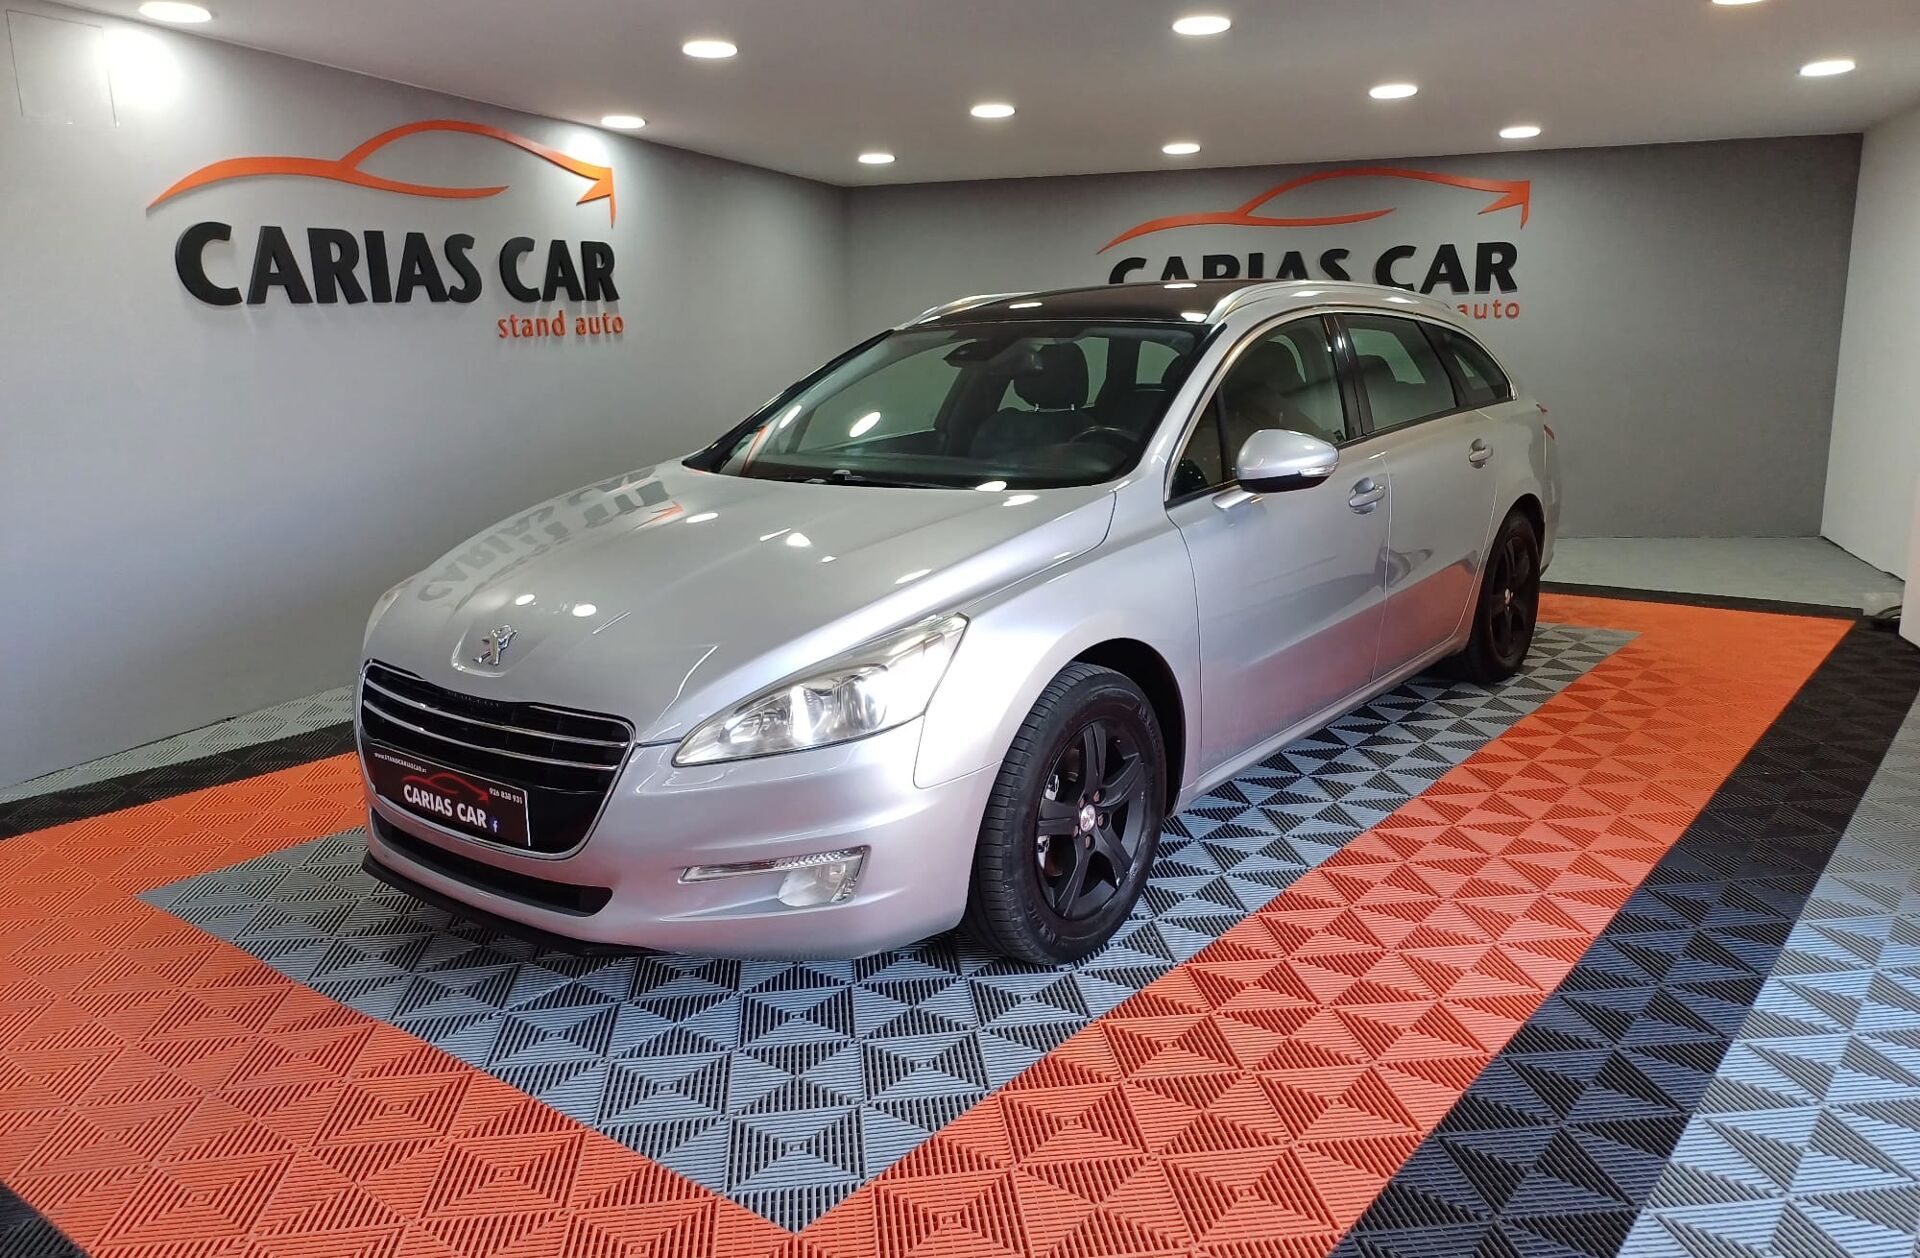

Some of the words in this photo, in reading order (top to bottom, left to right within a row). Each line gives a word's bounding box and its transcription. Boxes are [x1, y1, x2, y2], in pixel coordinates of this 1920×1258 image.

[175, 221, 482, 305] CARIAS
[499, 237, 620, 302] CAR
[1374, 241, 1518, 294] CAR
[498, 310, 566, 338] stand
[576, 312, 624, 335] auto
[403, 784, 453, 817] CARIAS
[457, 802, 488, 829] CAR
